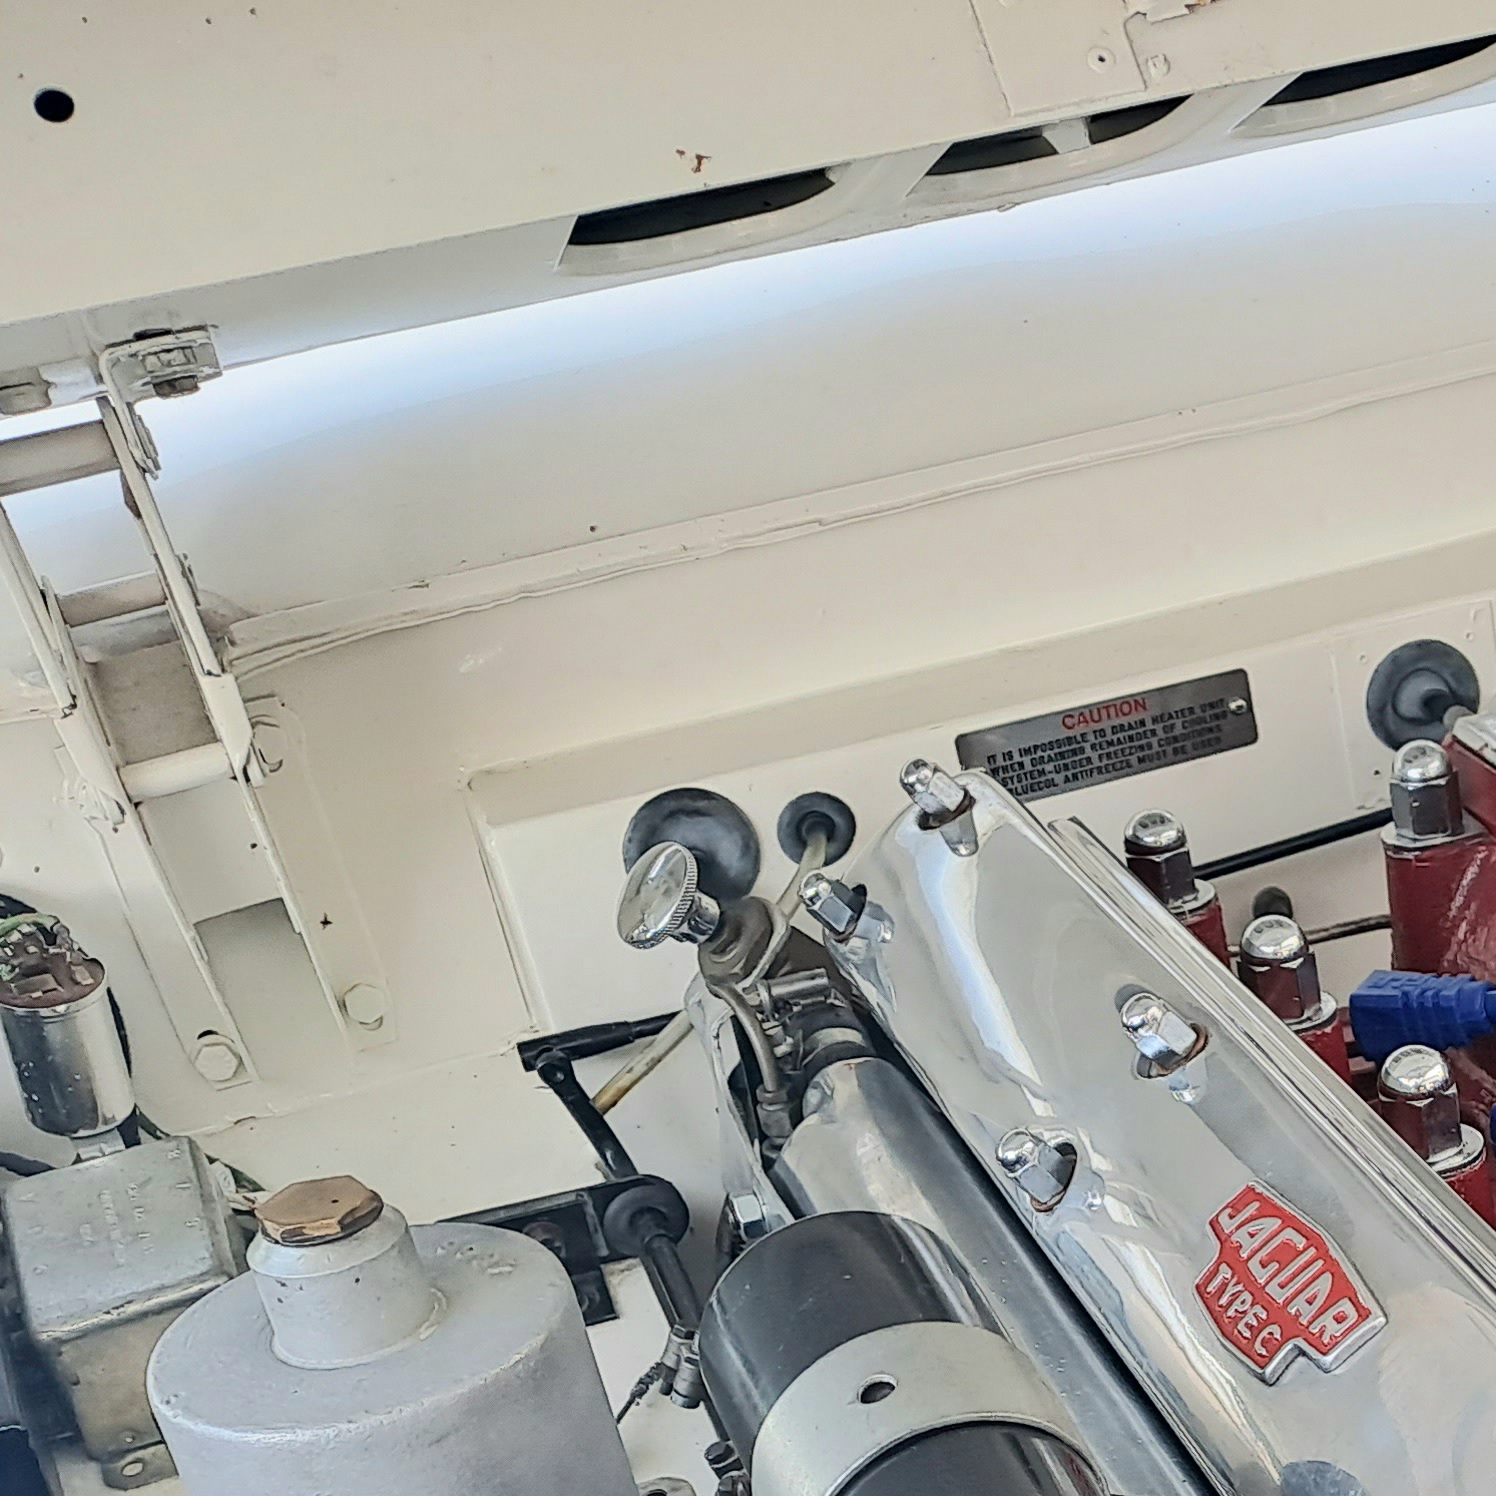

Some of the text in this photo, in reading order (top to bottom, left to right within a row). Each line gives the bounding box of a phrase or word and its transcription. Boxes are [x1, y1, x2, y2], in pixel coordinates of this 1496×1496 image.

[986, 754, 996, 765] IT
[1001, 750, 1014, 761] IS
[1018, 733, 1088, 756] IMPOSSIBLE
[1092, 728, 1106, 740] TO
[1110, 718, 1146, 735] DRAIN
[1150, 707, 1195, 724] HEATER
[1062, 698, 1147, 730] CAUTION
[989, 760, 1025, 778] WHEN
[1030, 746, 1086, 766] DRAINING
[1090, 728, 1158, 751] REMAINDER
[1161, 723, 1176, 735] OF
[1062, 759, 1132, 783] ANTIFREEZE
[1136, 749, 1167, 765] MUST
[1172, 745, 1187, 756] BE
[1097, 742, 1153, 762] FREEZING
[1217, 1200, 1359, 1347] JAGUAR
[1206, 1262, 1282, 1357] TYPE C
